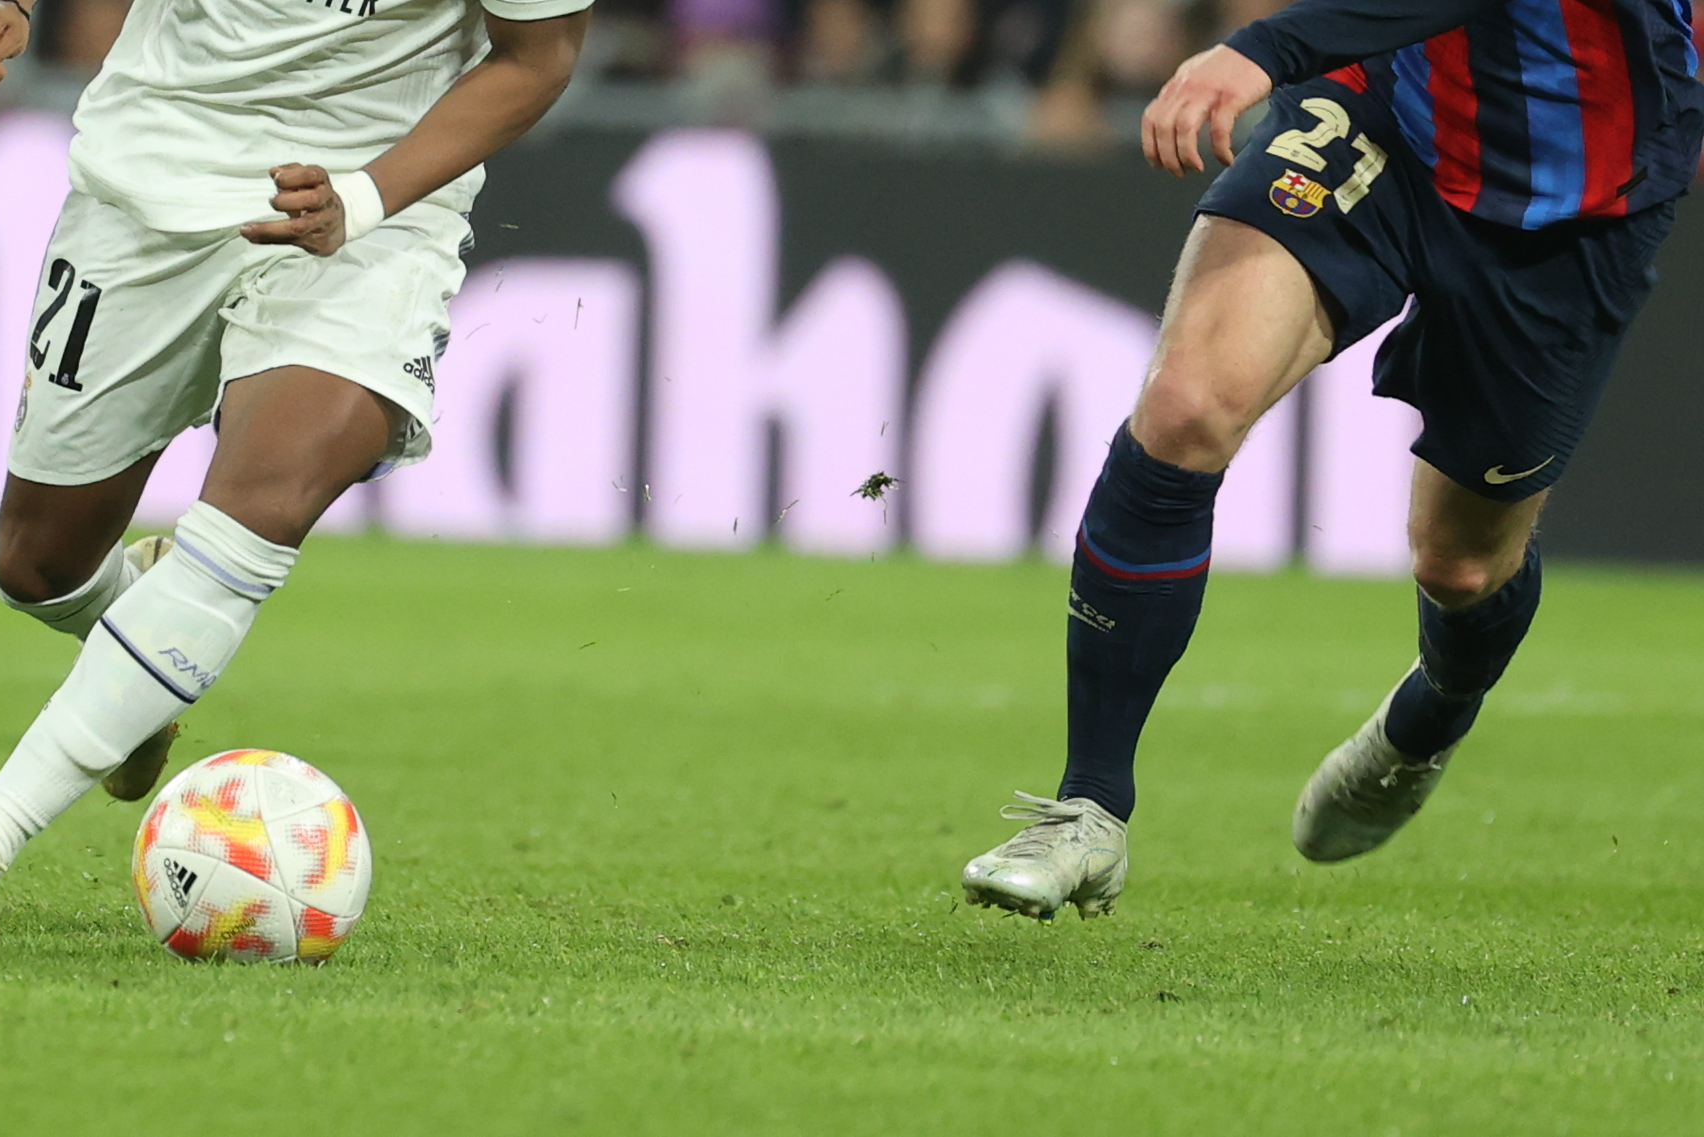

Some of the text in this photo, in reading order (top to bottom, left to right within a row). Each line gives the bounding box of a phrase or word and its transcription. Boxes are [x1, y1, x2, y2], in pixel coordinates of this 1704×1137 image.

[1265, 97, 1389, 215] 21
[29, 258, 102, 392] 21
[403, 362, 435, 395] adida
[163, 857, 187, 909] adidas
